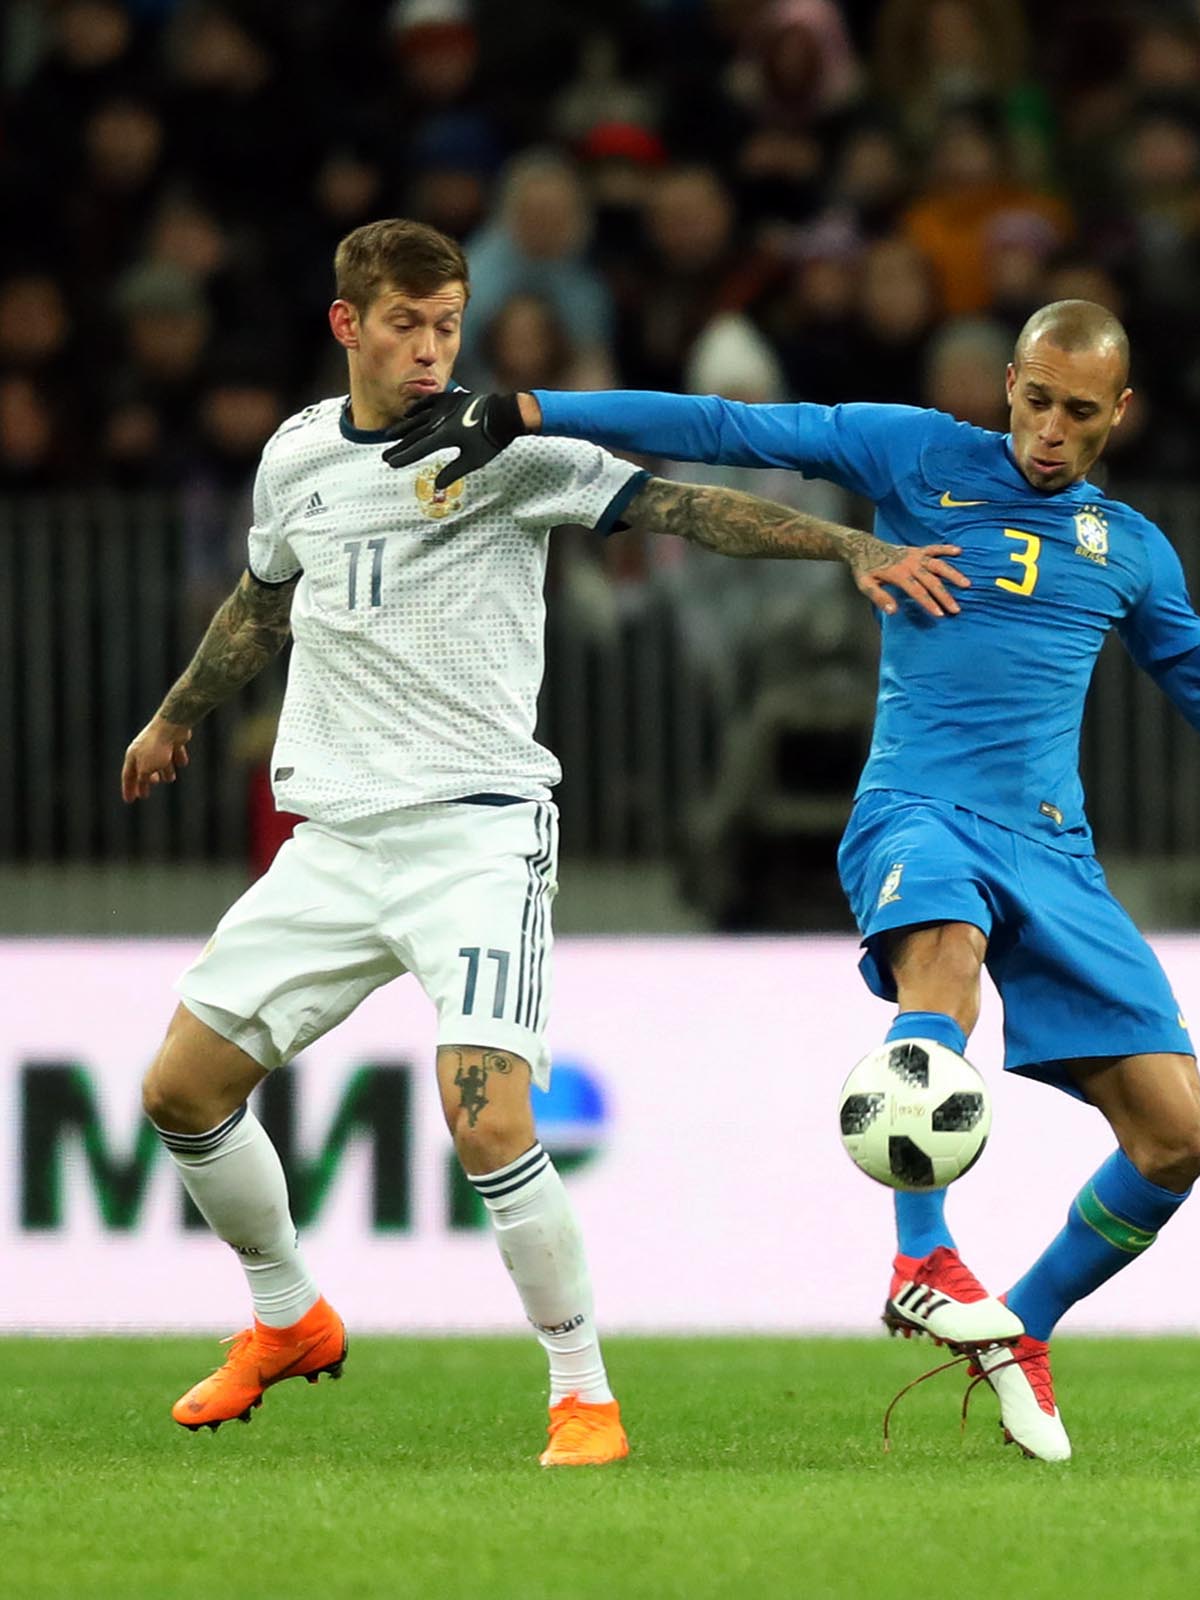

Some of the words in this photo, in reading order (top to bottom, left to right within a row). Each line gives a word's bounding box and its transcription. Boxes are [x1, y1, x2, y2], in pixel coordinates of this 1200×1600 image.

[343, 537, 388, 611] 11
[995, 528, 1042, 597] 3
[459, 946, 511, 1020] 11
